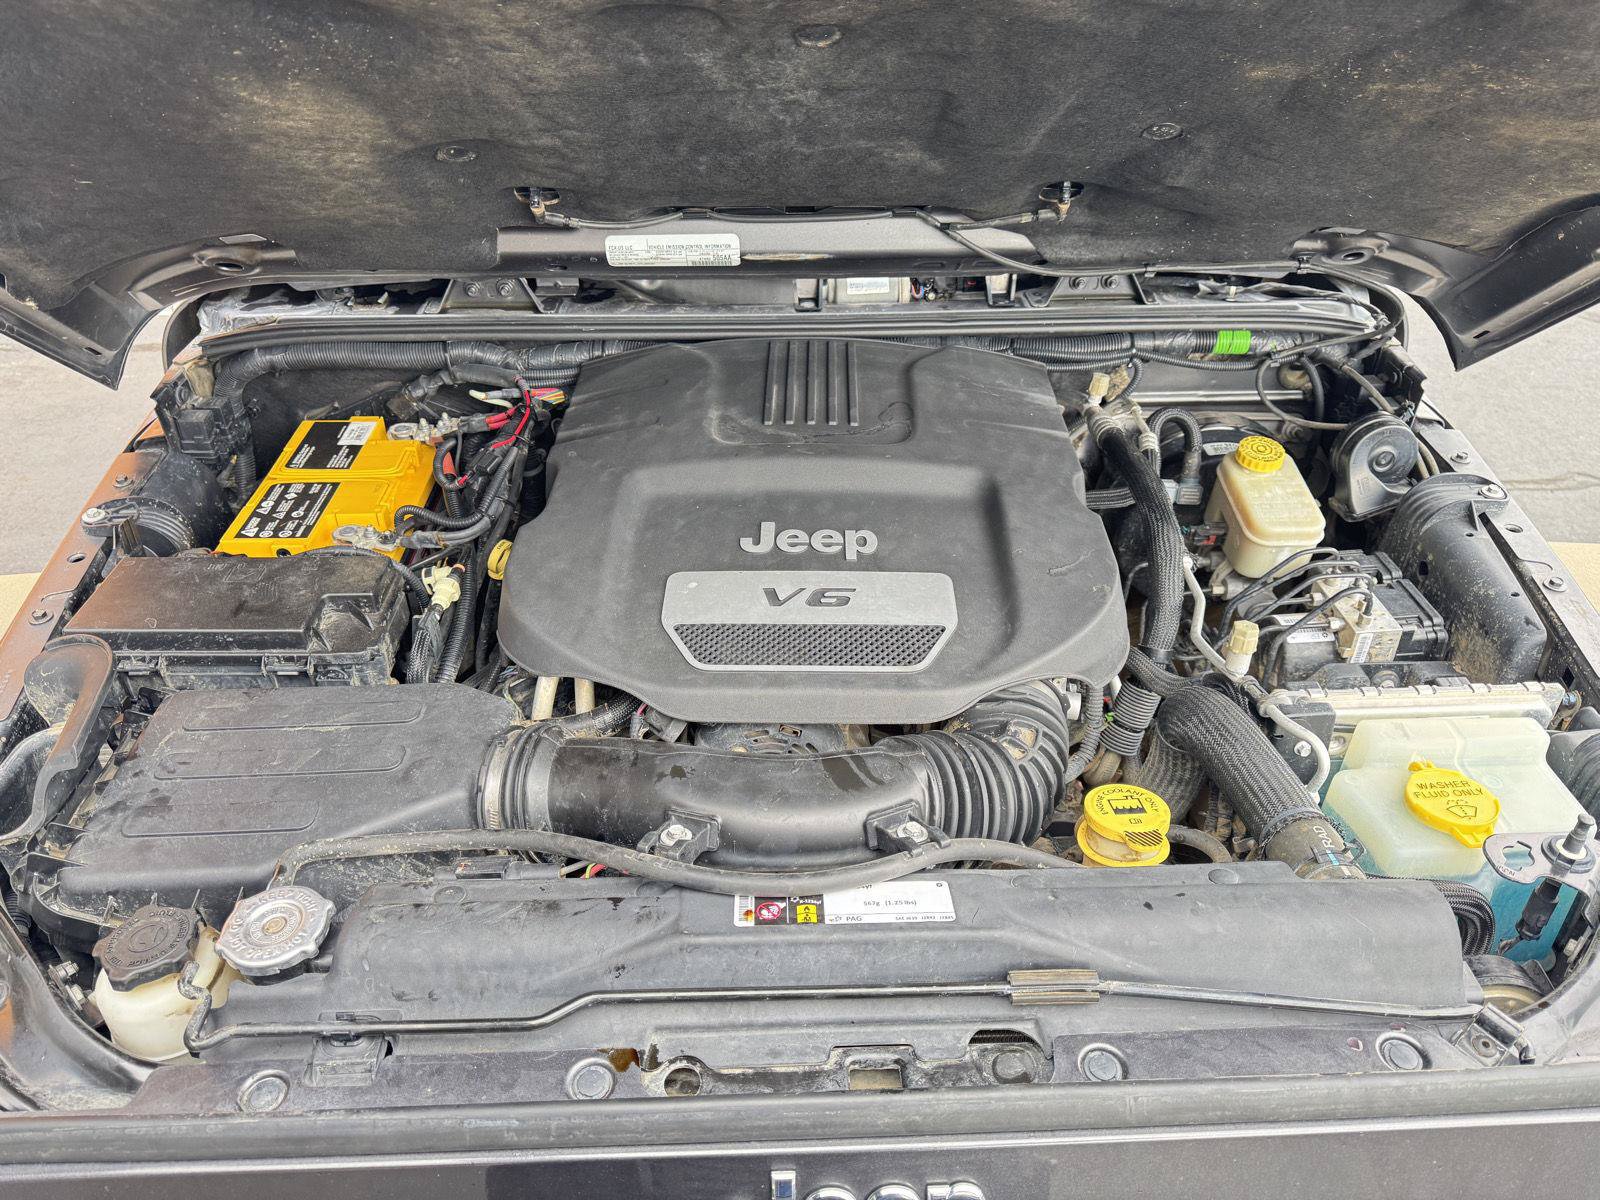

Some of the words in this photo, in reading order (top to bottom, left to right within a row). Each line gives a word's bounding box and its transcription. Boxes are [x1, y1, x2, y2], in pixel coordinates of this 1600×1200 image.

[738, 521, 878, 561] Jeep
[762, 587, 857, 608] V6
[1413, 790, 1450, 799] FLUID
[1452, 787, 1484, 797] ONLY
[1416, 780, 1471, 789] WASHER
[1102, 787, 1144, 797] COOLANT
[1144, 796, 1159, 813] ONLY
[1312, 825, 1336, 848] RAD
[259, 890, 294, 903] KEEP
